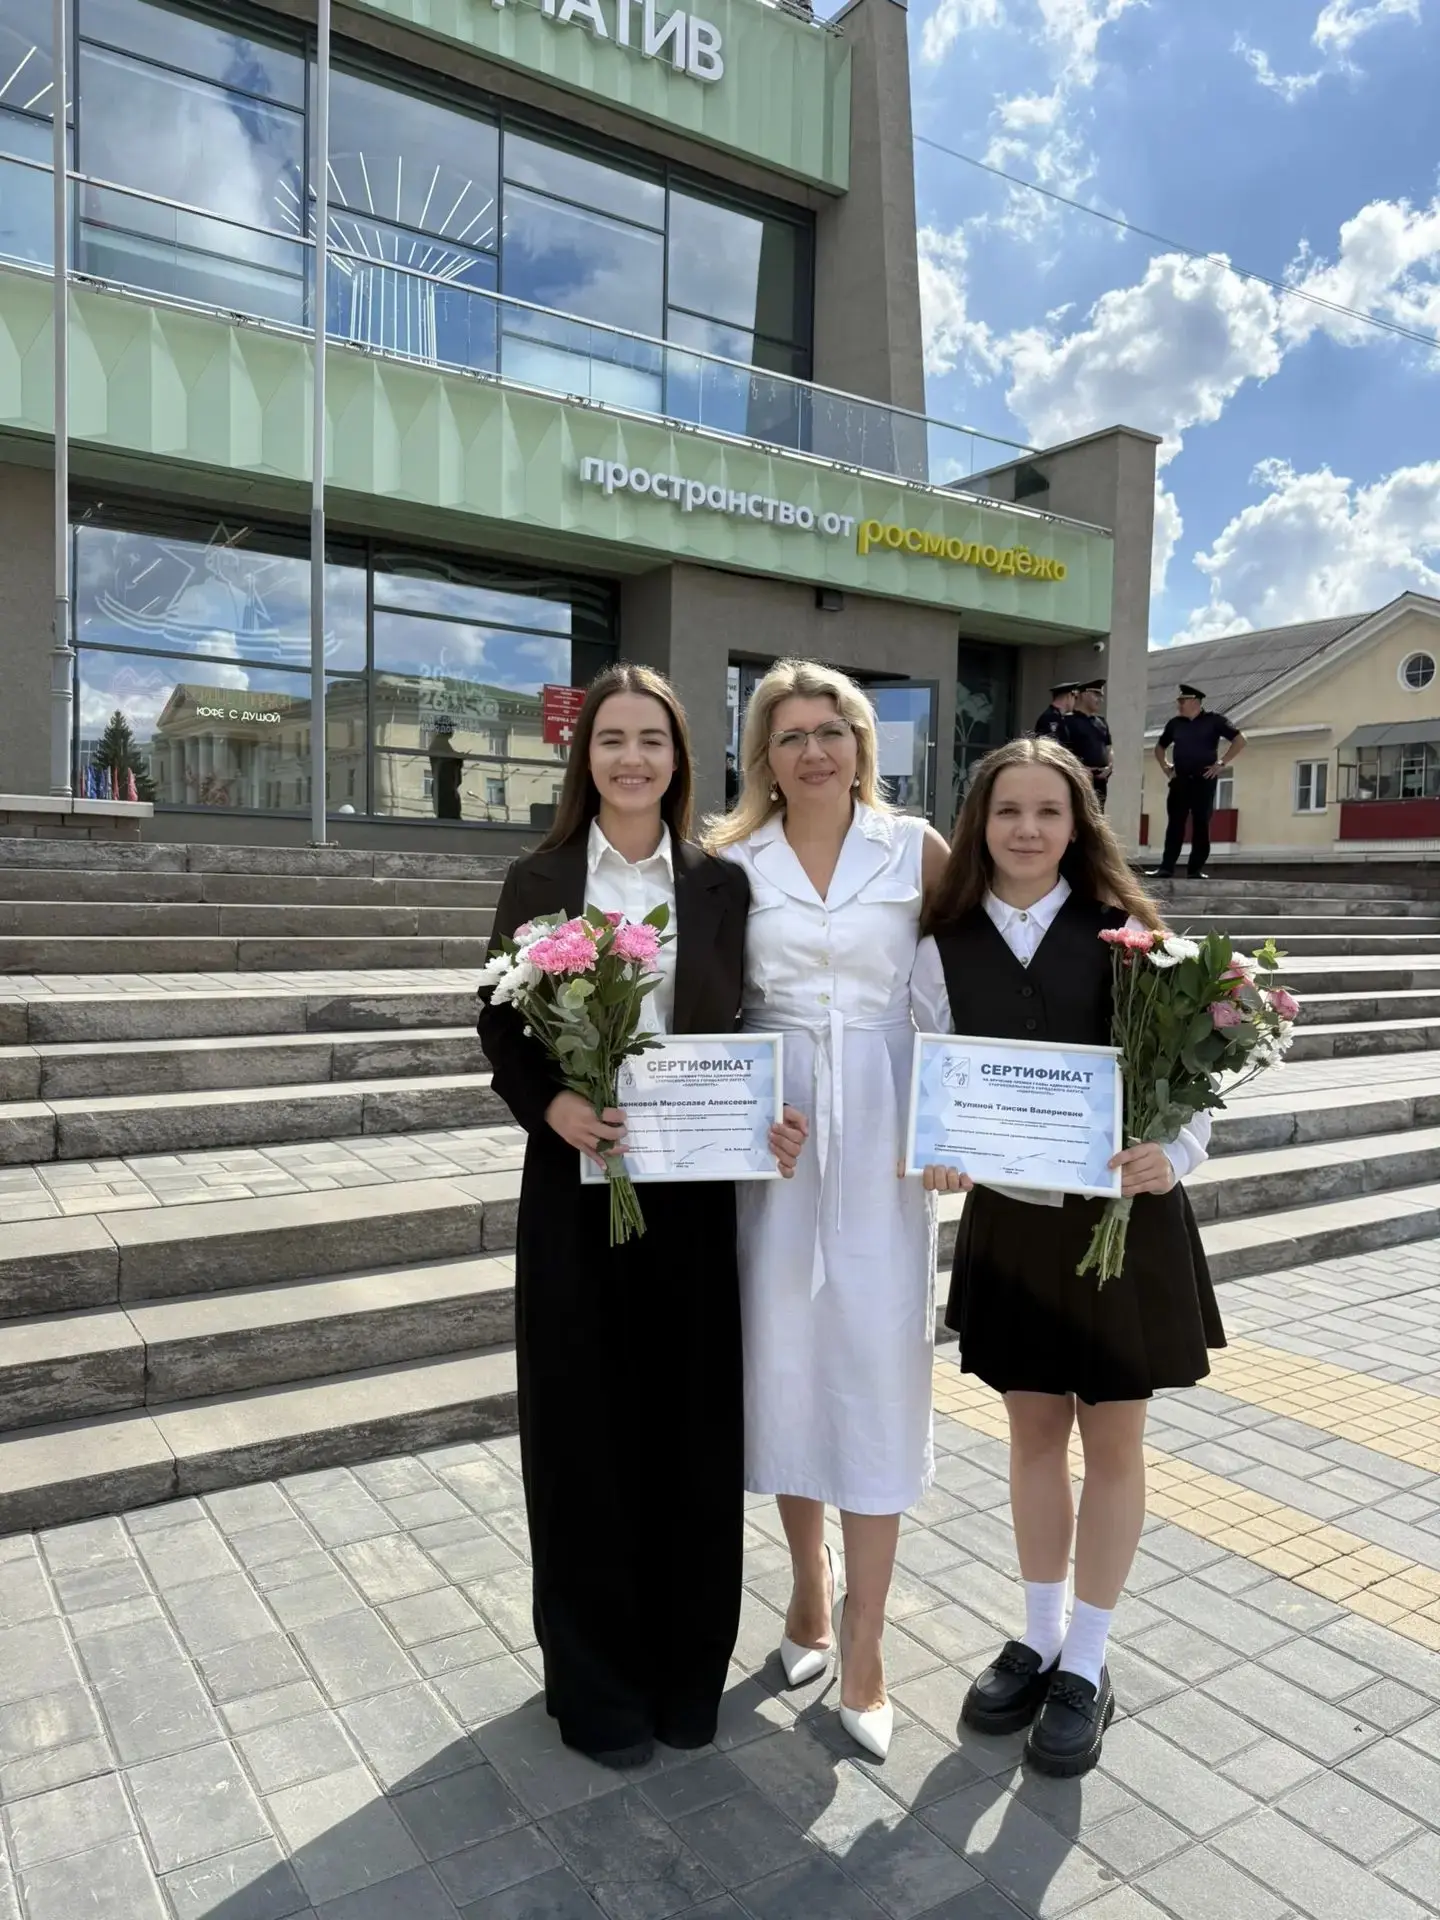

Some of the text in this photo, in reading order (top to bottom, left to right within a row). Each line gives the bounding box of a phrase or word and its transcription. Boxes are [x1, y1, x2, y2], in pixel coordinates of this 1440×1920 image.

[491, 0, 724, 83] АТИВ
[580, 456, 1067, 580] пространство от росмолодёжь
[196, 707, 281, 723] КОФЕ С ДУШОЙ
[647, 1060, 753, 1072] СЕРТИФИКАТ
[981, 1063, 1093, 1083] СЕРТИФИКАТ
[660, 1100, 706, 1108] Мирославе
[995, 1103, 1027, 1112] Таисии
[1030, 1106, 1083, 1118] Валериевне
